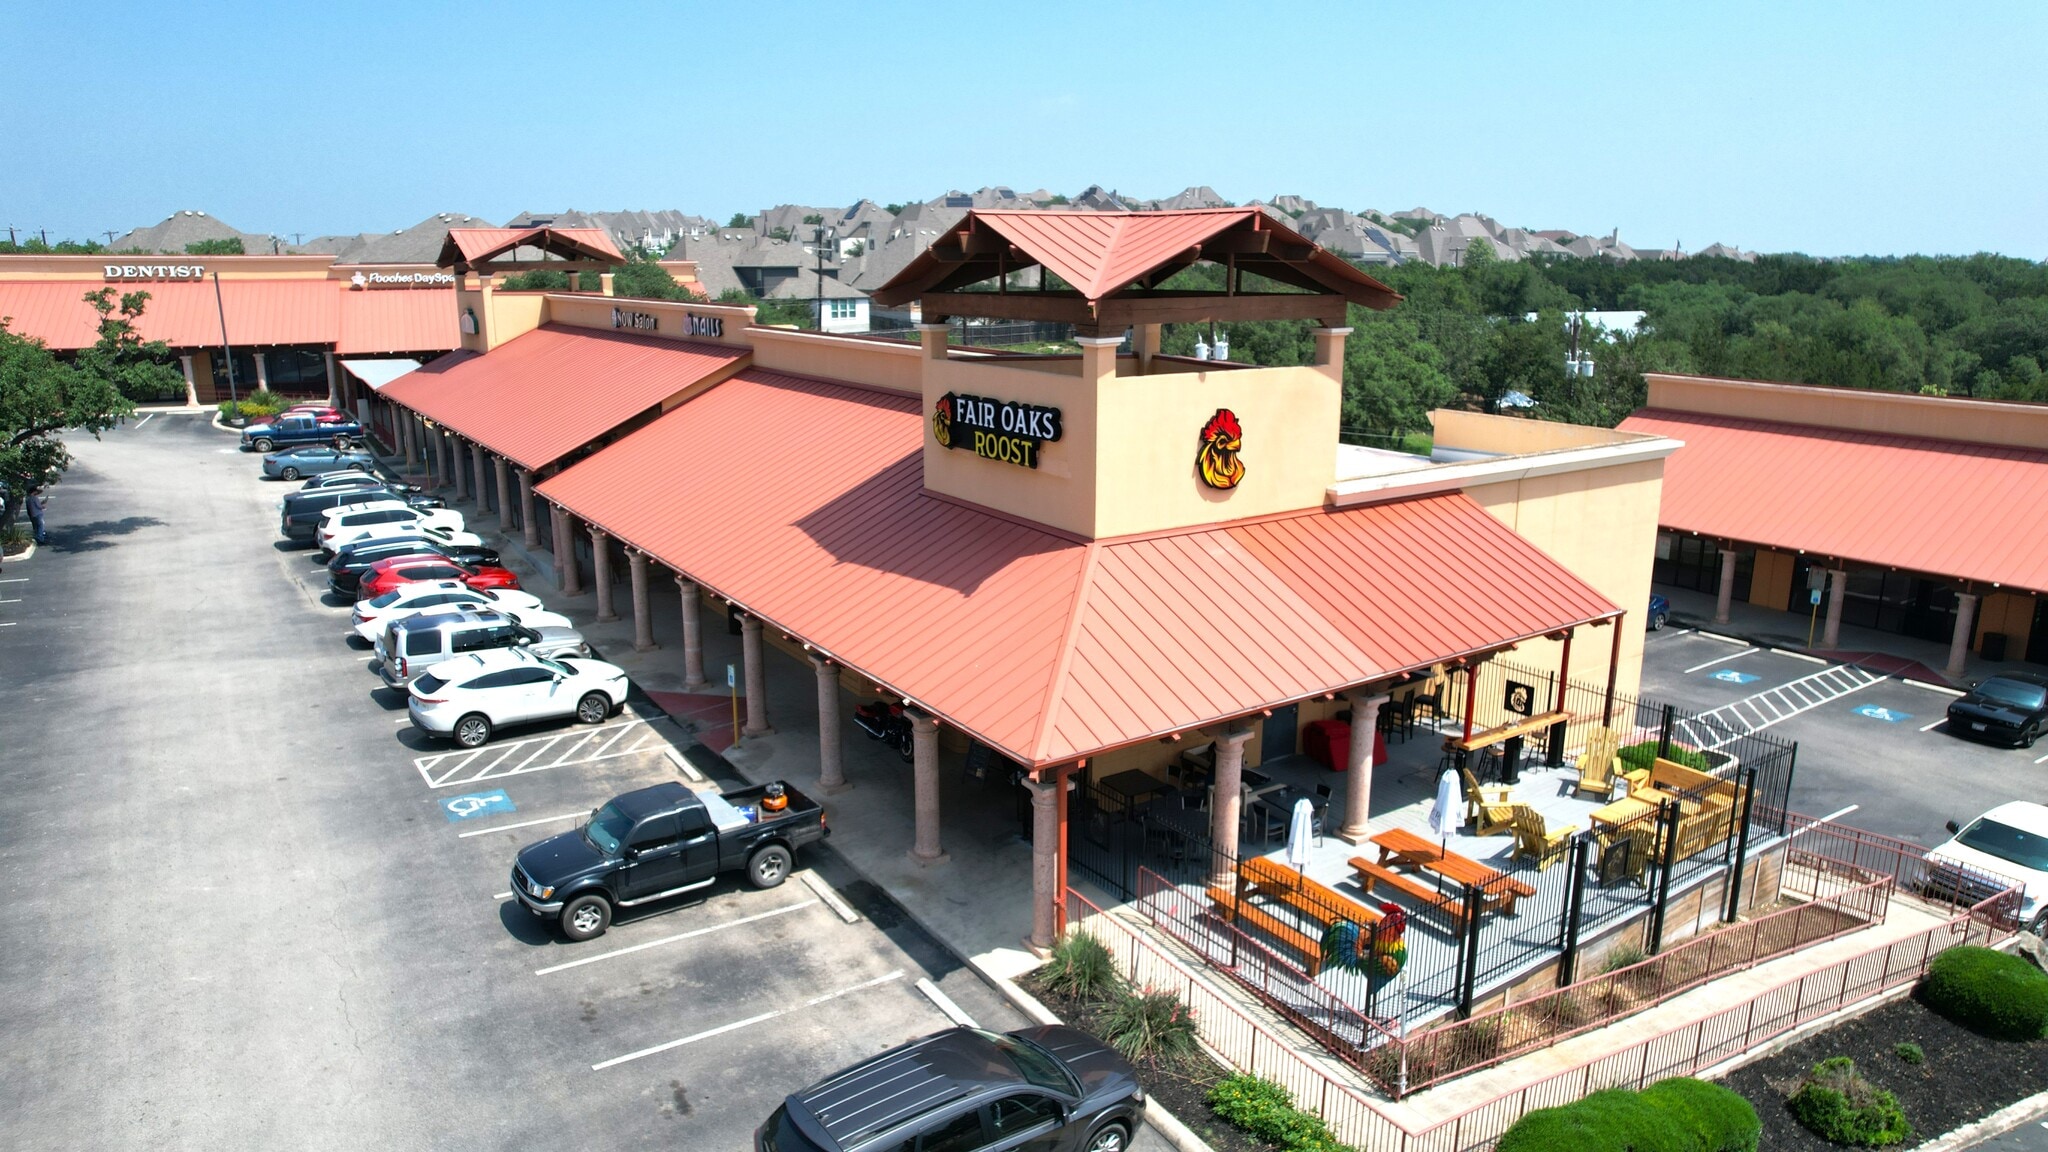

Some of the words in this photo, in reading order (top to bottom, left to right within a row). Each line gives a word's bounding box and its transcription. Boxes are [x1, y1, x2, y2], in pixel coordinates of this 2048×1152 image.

[104, 265, 204, 278] DENTIST
[369, 272, 413, 283] Pooches
[956, 398, 995, 429] FAIR
[1001, 405, 1055, 439] OAKS
[975, 431, 1032, 467] ROOST
